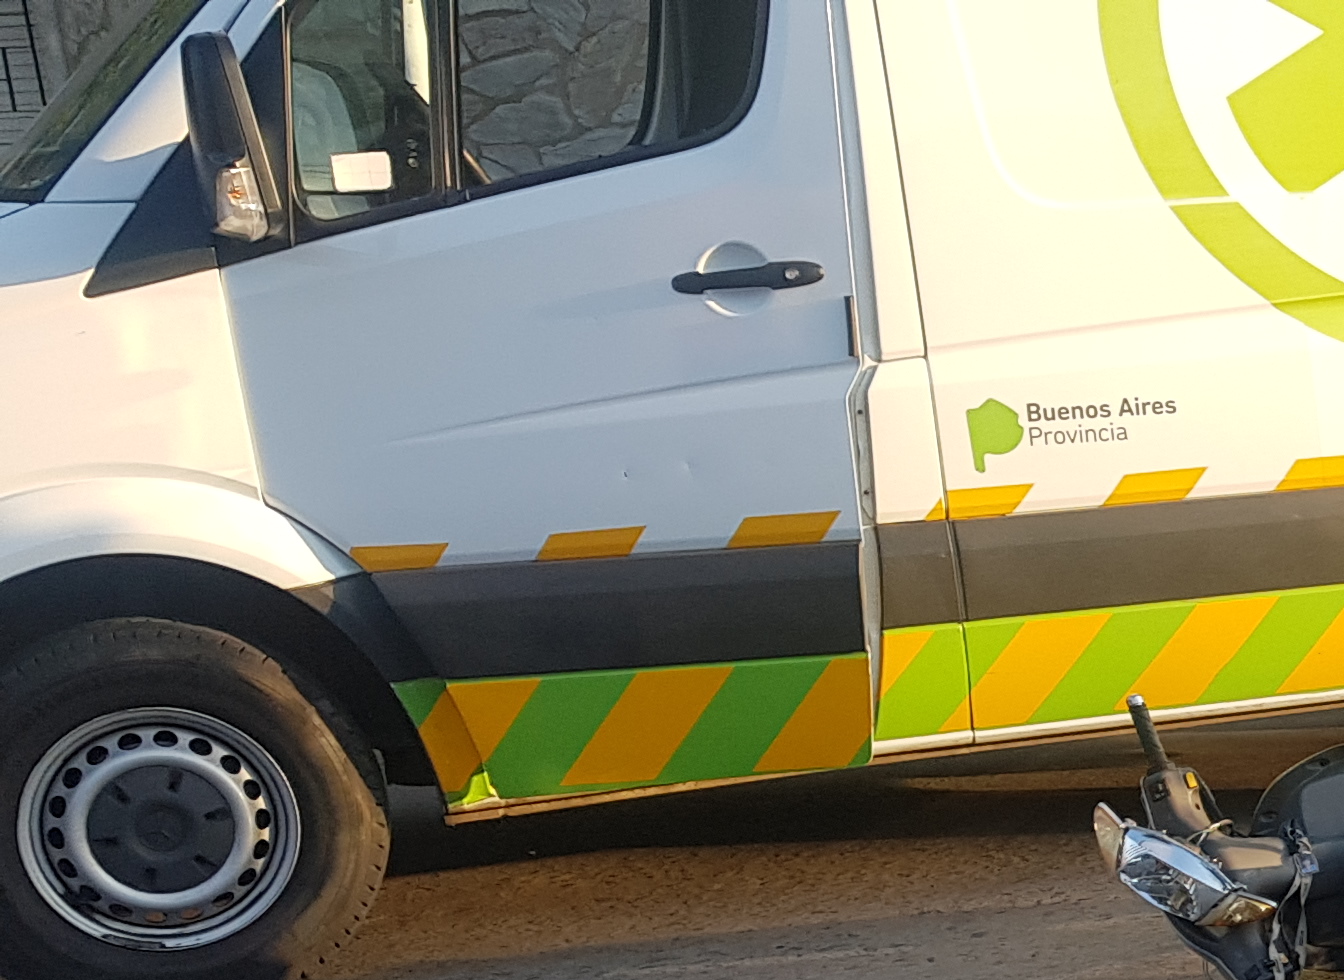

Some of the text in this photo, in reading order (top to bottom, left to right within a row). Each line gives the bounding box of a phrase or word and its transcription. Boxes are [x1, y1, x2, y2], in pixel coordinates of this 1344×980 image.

[1026, 397, 1177, 422] Buenos Aires
[1028, 422, 1129, 446] Provincia
